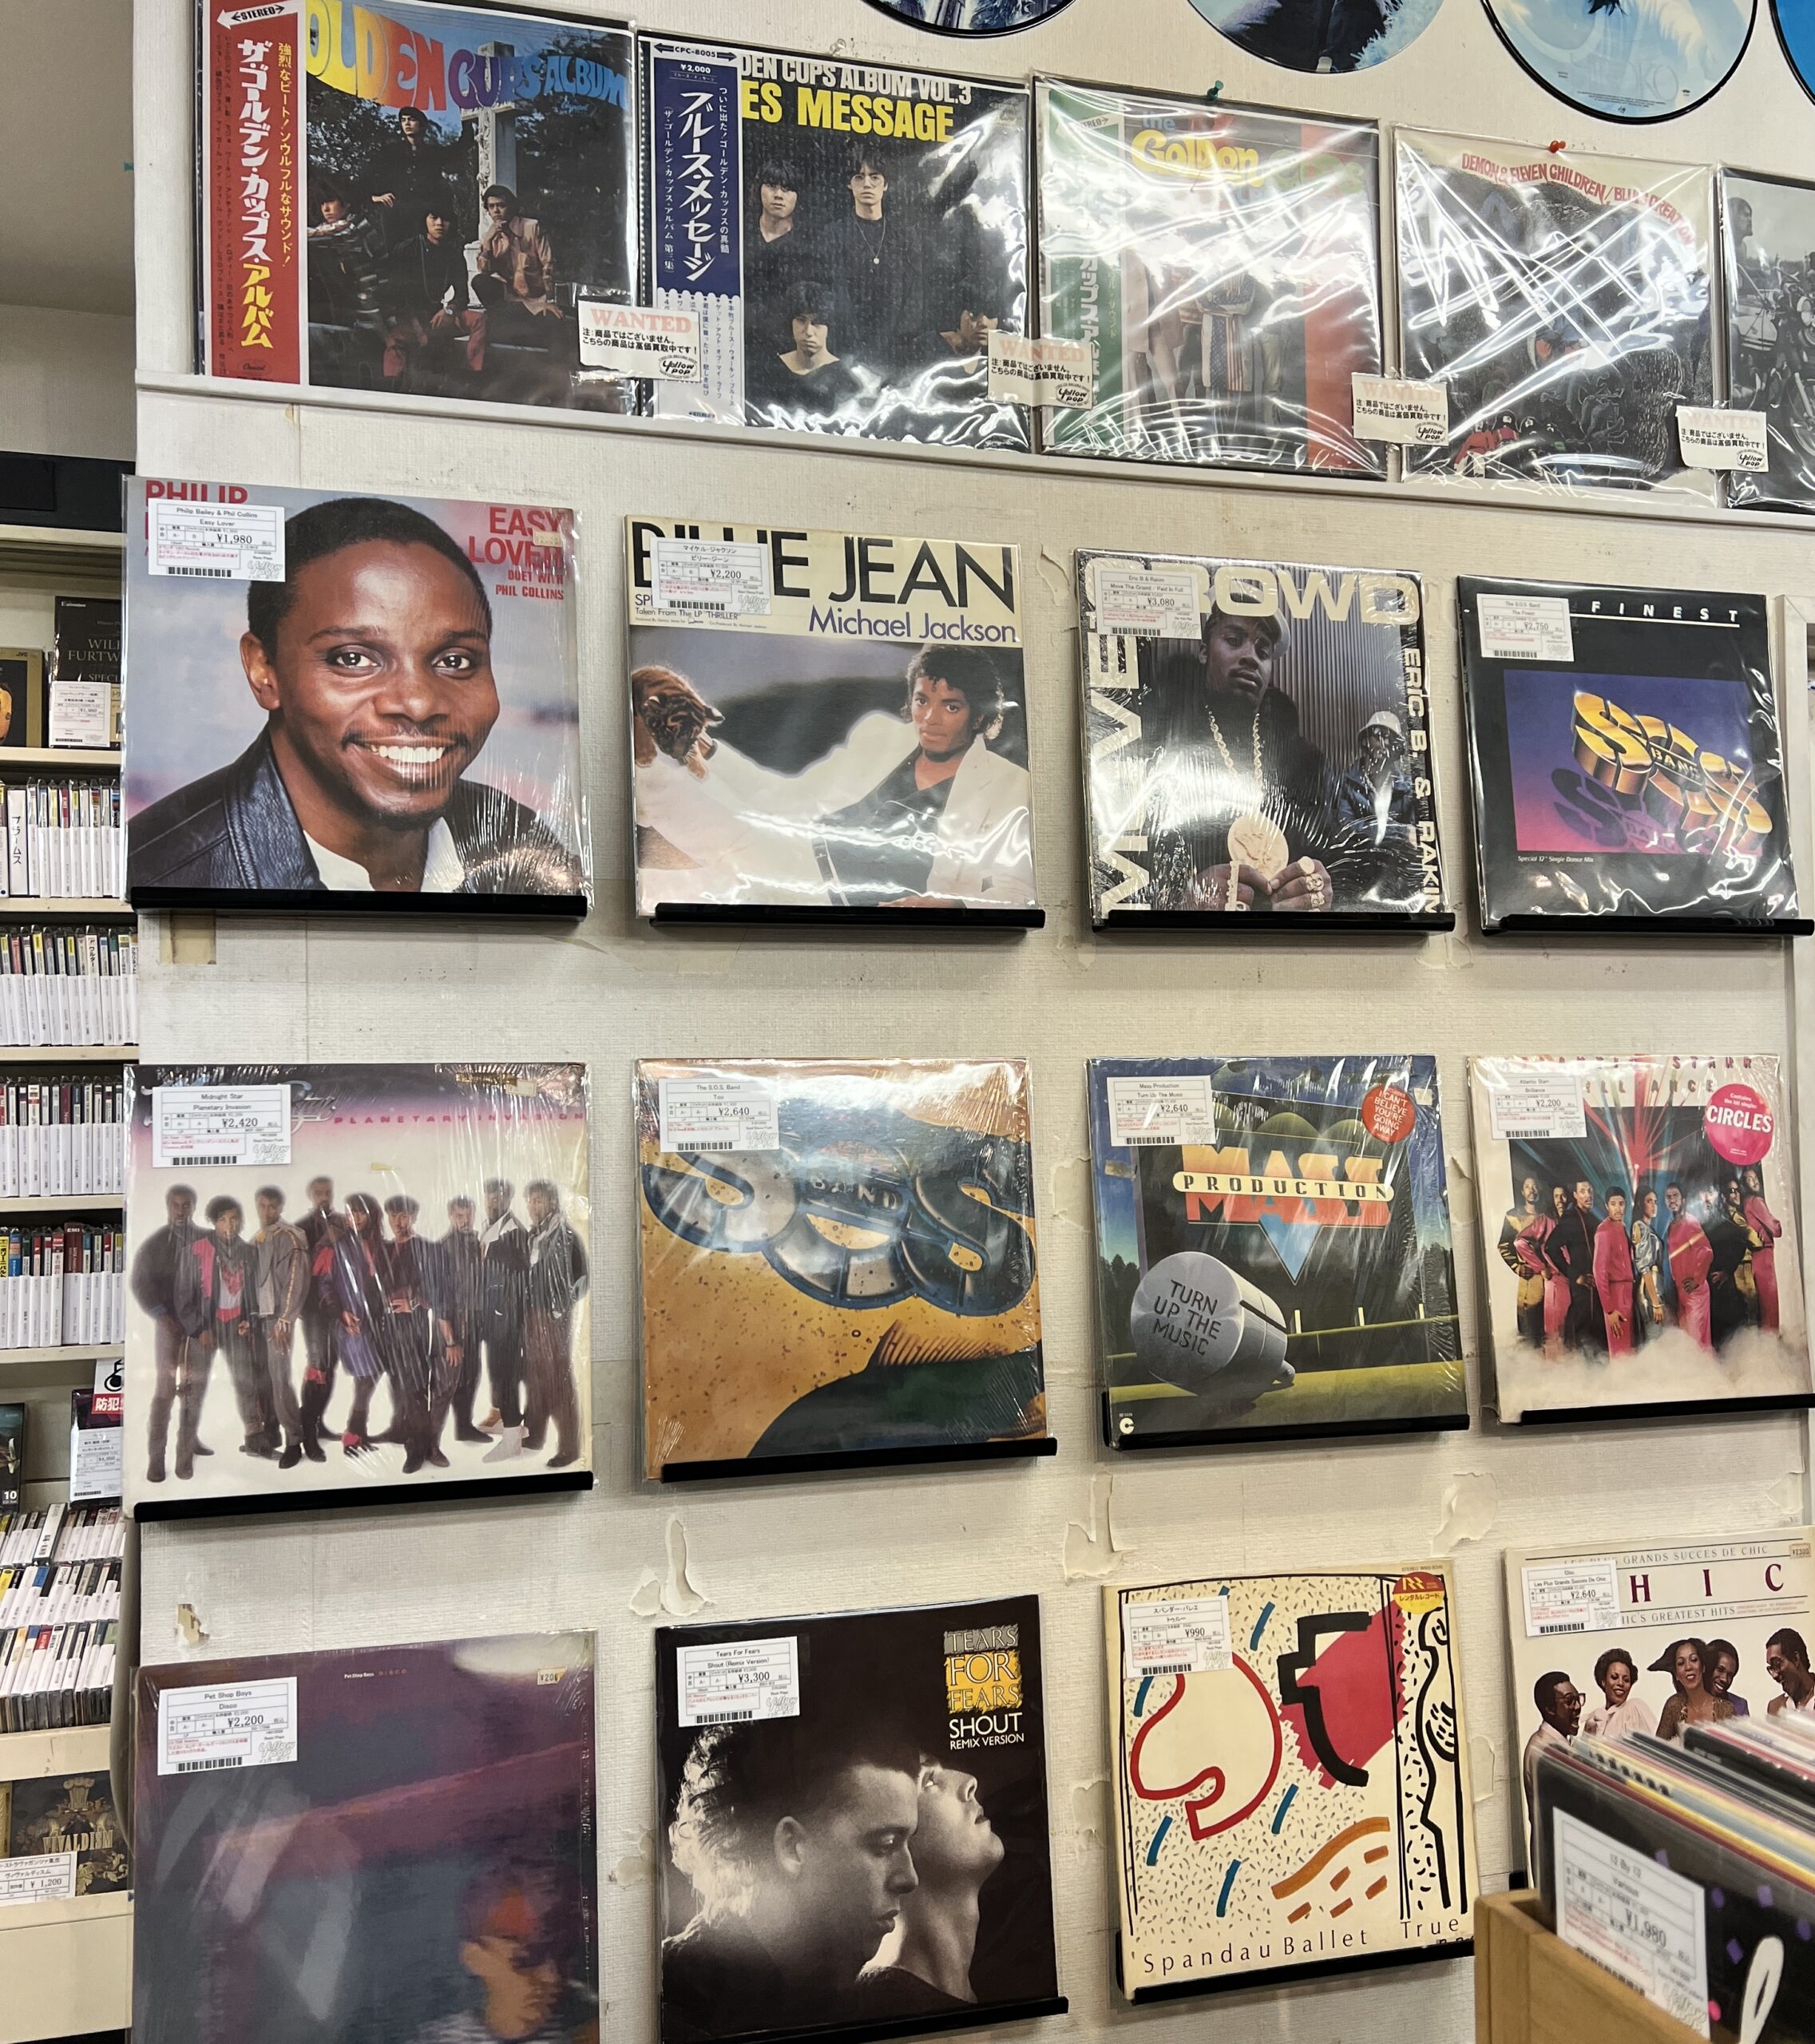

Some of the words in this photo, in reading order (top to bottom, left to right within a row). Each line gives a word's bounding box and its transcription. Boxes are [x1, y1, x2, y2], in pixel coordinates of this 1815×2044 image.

[241, 5, 276, 22] STEREO
[675, 46, 716, 58] CPC-8005
[680, 63, 711, 74] ¥2,000
[448, 49, 542, 109] CUPS
[544, 54, 627, 107] ALBUM
[782, 57, 837, 88] CUPS
[841, 67, 913, 99] ALBUM
[917, 77, 972, 105] VOL.3
[742, 81, 783, 123] ES
[798, 86, 954, 143] MESSAGE
[677, 92, 716, 281] ブルース・メッセージ
[1461, 153, 1499, 182] DEMON
[1509, 163, 1549, 184] ELEVEN
[1549, 164, 1611, 205] CHILDREN
[590, 308, 692, 333] WANTED
[999, 339, 1085, 362] WANTED
[1361, 382, 1441, 402] WANTED
[196, 508, 215, 517] Bailey
[489, 506, 564, 537] EASY
[216, 533, 253, 545] ¥1,980
[508, 570, 533, 581] DUET
[538, 572, 564, 584] WITH
[710, 568, 742, 580] ¥2,200
[828, 533, 1016, 615] JEAN
[496, 584, 518, 596] PHIL
[522, 586, 564, 600] COLLINS
[1147, 597, 1175, 607] ¥3,080
[636, 607, 656, 616] Taken
[658, 608, 677, 617] From
[679, 609, 692, 618] The
[694, 609, 703, 618] LP
[1591, 600, 1739, 623] FINEST
[808, 604, 912, 640] Michael
[918, 613, 1017, 644] Jackson
[1524, 621, 1549, 631] ¥2,750
[68, 651, 119, 661] FURTW
[1404, 648, 1425, 718] ERIC
[1415, 777, 1432, 798] &
[11, 815, 22, 865] ブラームス
[1417, 821, 1441, 914] RAKIM
[1160, 1103, 1188, 1114] ¥2,640
[1373, 1096, 1408, 1116] BELIEVE
[1383, 1091, 1408, 1107] CAN'T
[1536, 1099, 1561, 1107] ¥2,200
[334, 1115, 466, 1124] PLANETARY
[719, 1107, 750, 1117] ¥2,640
[1374, 1105, 1404, 1123] YOU'RE
[1706, 1105, 1772, 1133] CIRCLES
[222, 1118, 258, 1128] ¥2,420
[1373, 1114, 1400, 1131] GOING
[1373, 1122, 1396, 1136] AWAY
[1181, 1145, 1392, 1227] MASS
[1182, 1175, 1389, 1200] PRODUCTION
[1170, 1279, 1219, 1316] TURN
[1154, 1295, 1180, 1321] UP
[1185, 1307, 1222, 1341] THE
[1152, 1320, 1211, 1357] MUSIC
[3, 1490, 18, 1500] 10
[1623, 1552, 1670, 1565] GRANDS
[1673, 1548, 1718, 1562] SUCCES
[1722, 1547, 1738, 1557] DE
[1741, 1544, 1769, 1555] CHIC
[1399, 1592, 1441, 1602] レンタルレコード
[1571, 1589, 1596, 1599] ¥2,640
[1651, 1607, 1706, 1622] GREATEST
[1711, 1606, 1735, 1616] HITS
[946, 1626, 1017, 1653] TEARS
[1185, 1627, 1206, 1638] ¥990
[738, 1671, 771, 1683] ¥3,300
[948, 1650, 1016, 1687] FOR
[949, 1685, 1021, 1712] FEARS
[228, 1714, 264, 1728] ¥2,200
[949, 1713, 1023, 1739] SHOUT
[949, 1736, 981, 1750] REMIX
[981, 1733, 1024, 1747] VERSION
[42, 1829, 113, 1855] VIVALDISM
[40, 1878, 62, 1888] 1,200
[1626, 1908, 1667, 1948] ¥1,980
[1143, 1943, 1271, 1977] Spandau
[1284, 1927, 1369, 1956] Ballet
[1400, 1916, 1460, 1941] True
